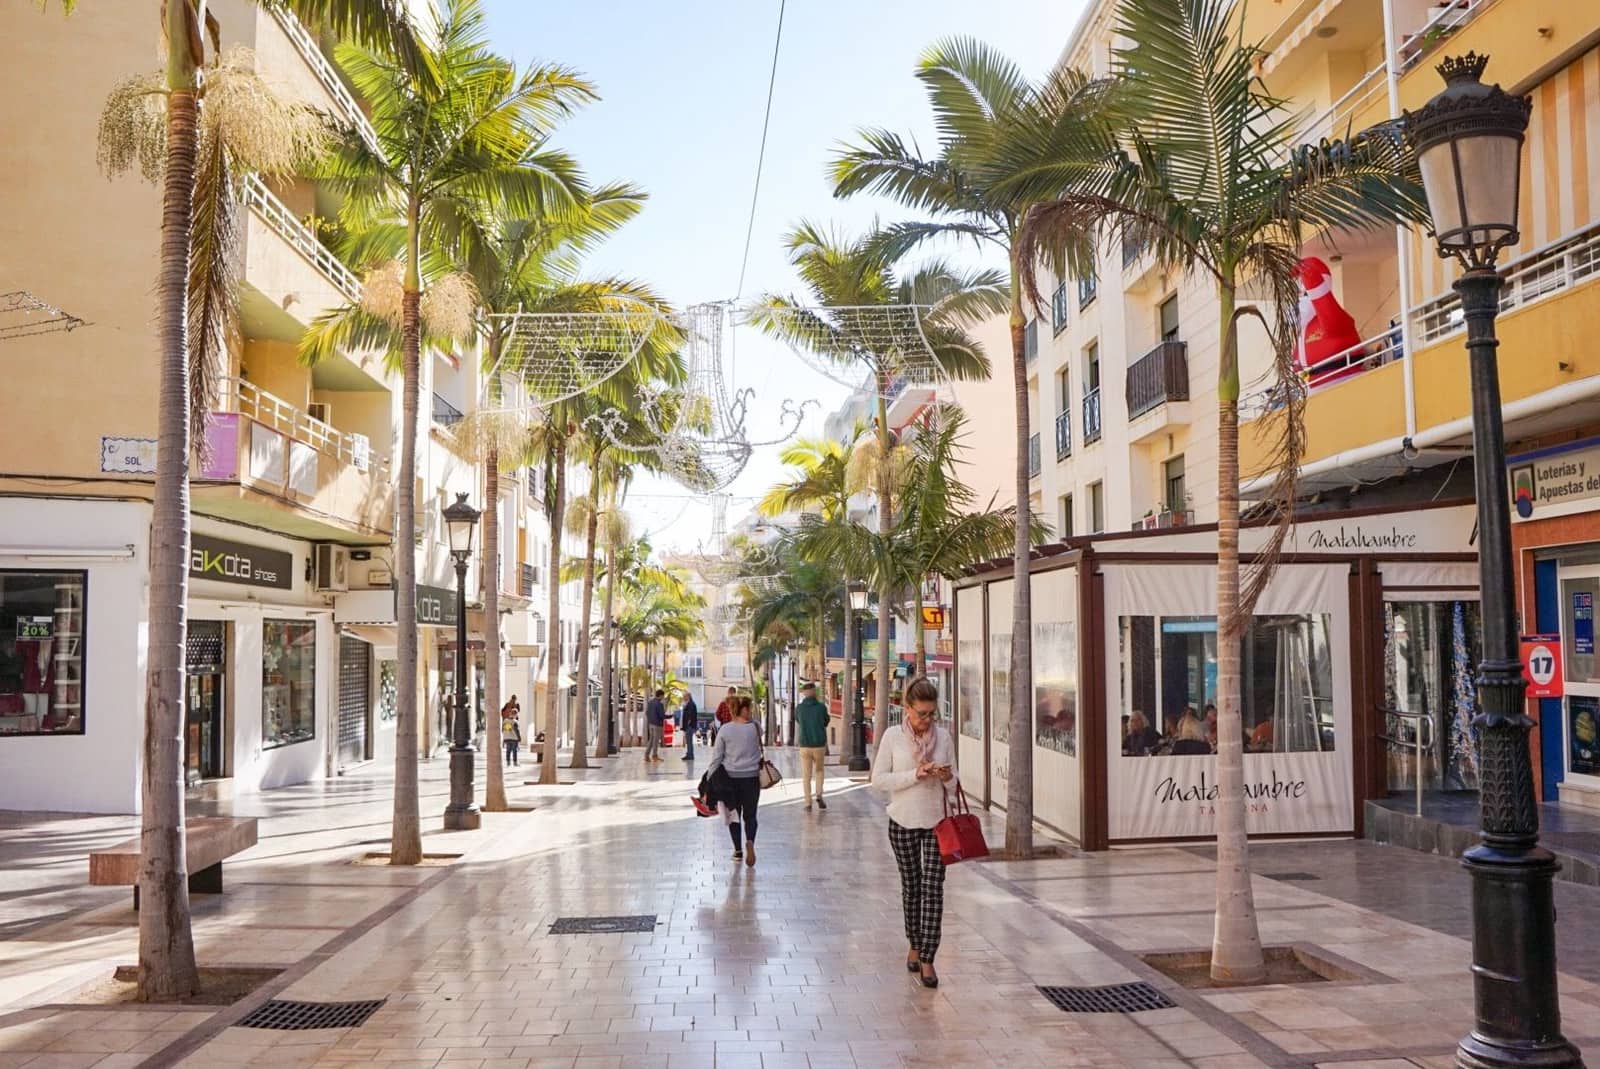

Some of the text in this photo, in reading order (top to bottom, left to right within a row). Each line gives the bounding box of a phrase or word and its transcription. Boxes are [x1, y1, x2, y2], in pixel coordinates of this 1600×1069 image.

[124, 456, 142, 466] SOL
[1579, 462, 1585, 477] y
[1540, 481, 1584, 502] Apuestas
[1308, 526, 1417, 549] Matahambre
[254, 567, 277, 582] shoes
[22, 626, 49, 636] 20%
[1530, 656, 1553, 674] 17
[1154, 770, 1306, 804] Mataambre
